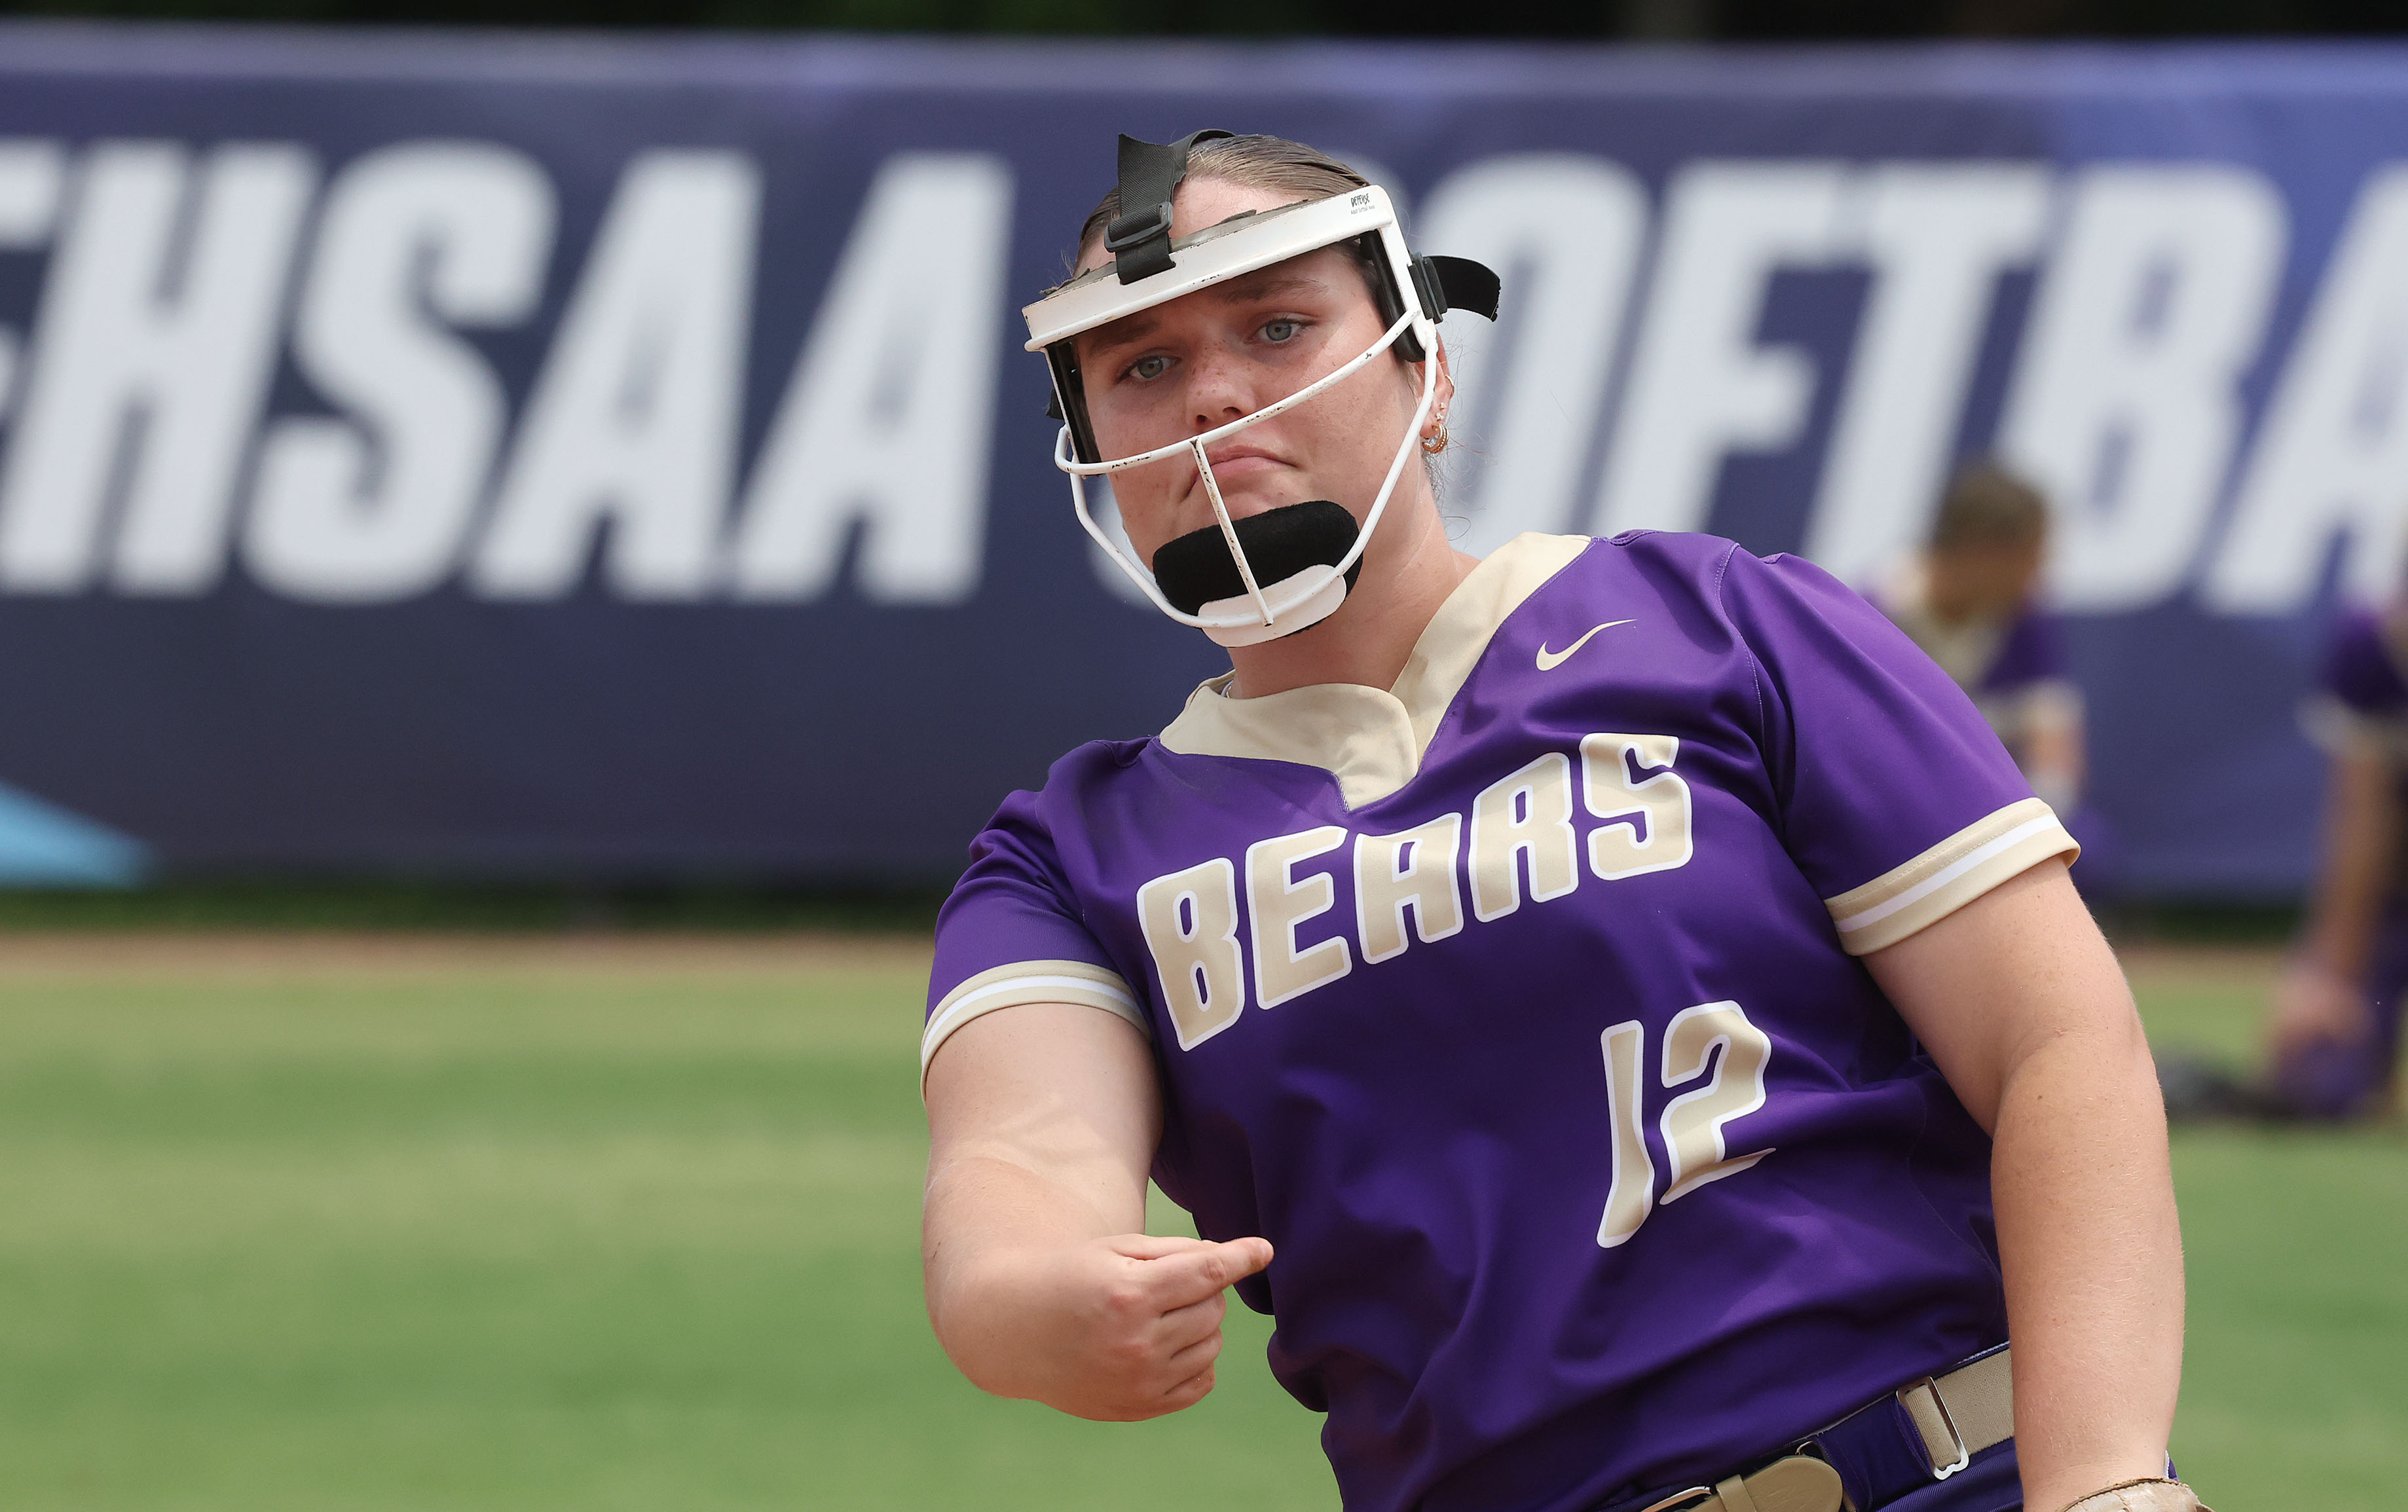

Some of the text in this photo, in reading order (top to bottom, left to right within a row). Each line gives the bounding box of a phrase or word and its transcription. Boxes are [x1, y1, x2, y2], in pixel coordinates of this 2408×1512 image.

[1350, 193, 1370, 208] DEFENSE
[0, 136, 2408, 616] HSAA OFTBA
[1137, 732, 1694, 1052] BEARS
[1596, 999, 1777, 1248] 12
